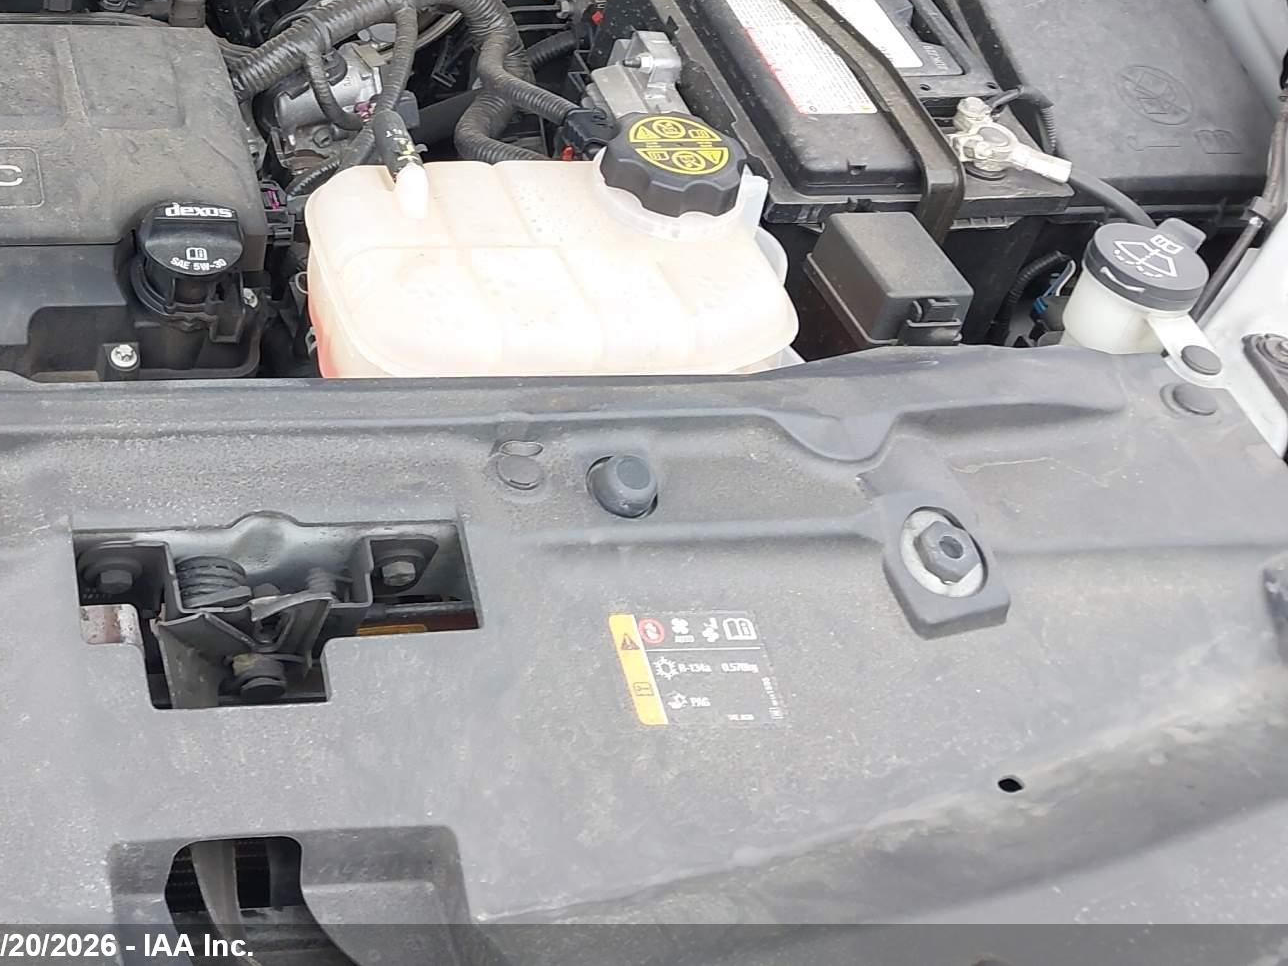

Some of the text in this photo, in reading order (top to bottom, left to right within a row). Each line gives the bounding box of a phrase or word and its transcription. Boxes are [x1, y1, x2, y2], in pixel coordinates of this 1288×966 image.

[165, 202, 233, 218] dexos
[170, 257, 227, 271] SAE 5W-30
